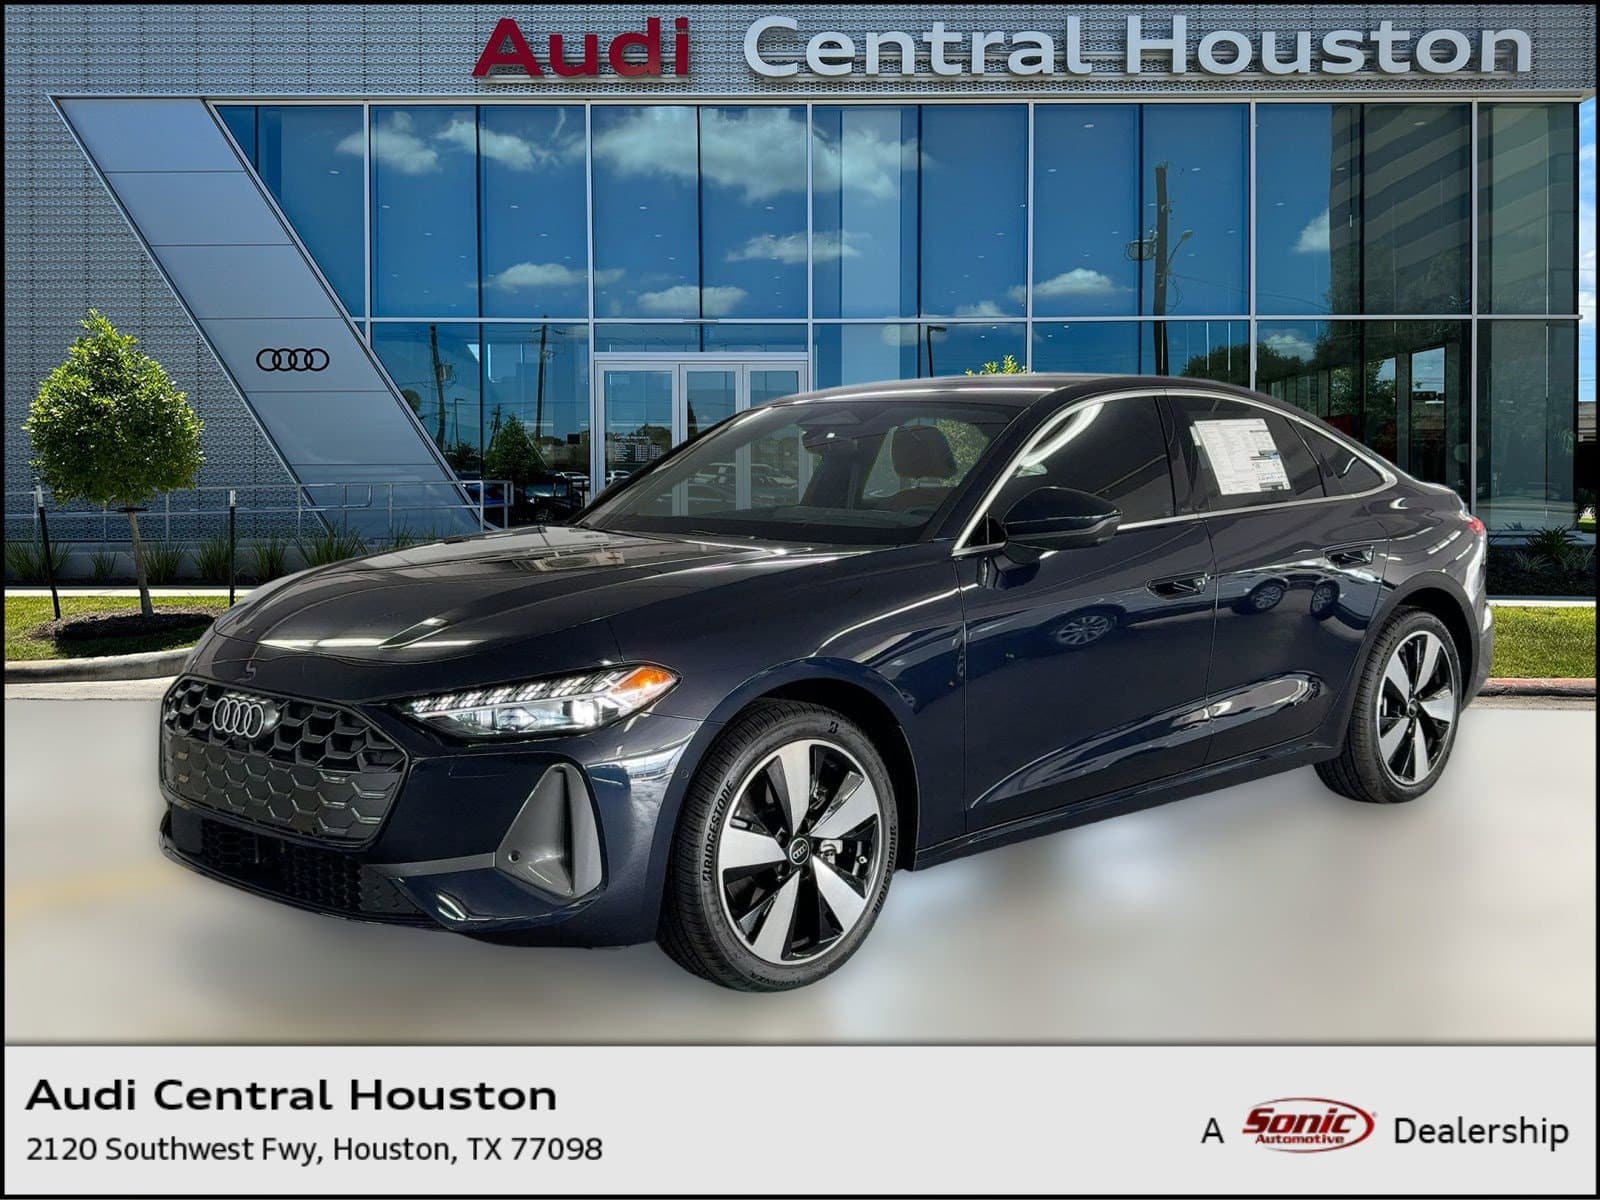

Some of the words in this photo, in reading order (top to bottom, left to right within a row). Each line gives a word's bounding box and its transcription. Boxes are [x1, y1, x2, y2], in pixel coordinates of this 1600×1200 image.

[472, 17, 690, 77] Audi
[743, 15, 1093, 77] Central
[1125, 15, 1532, 75] Houston
[702, 780, 734, 882] BRIDGESTONE
